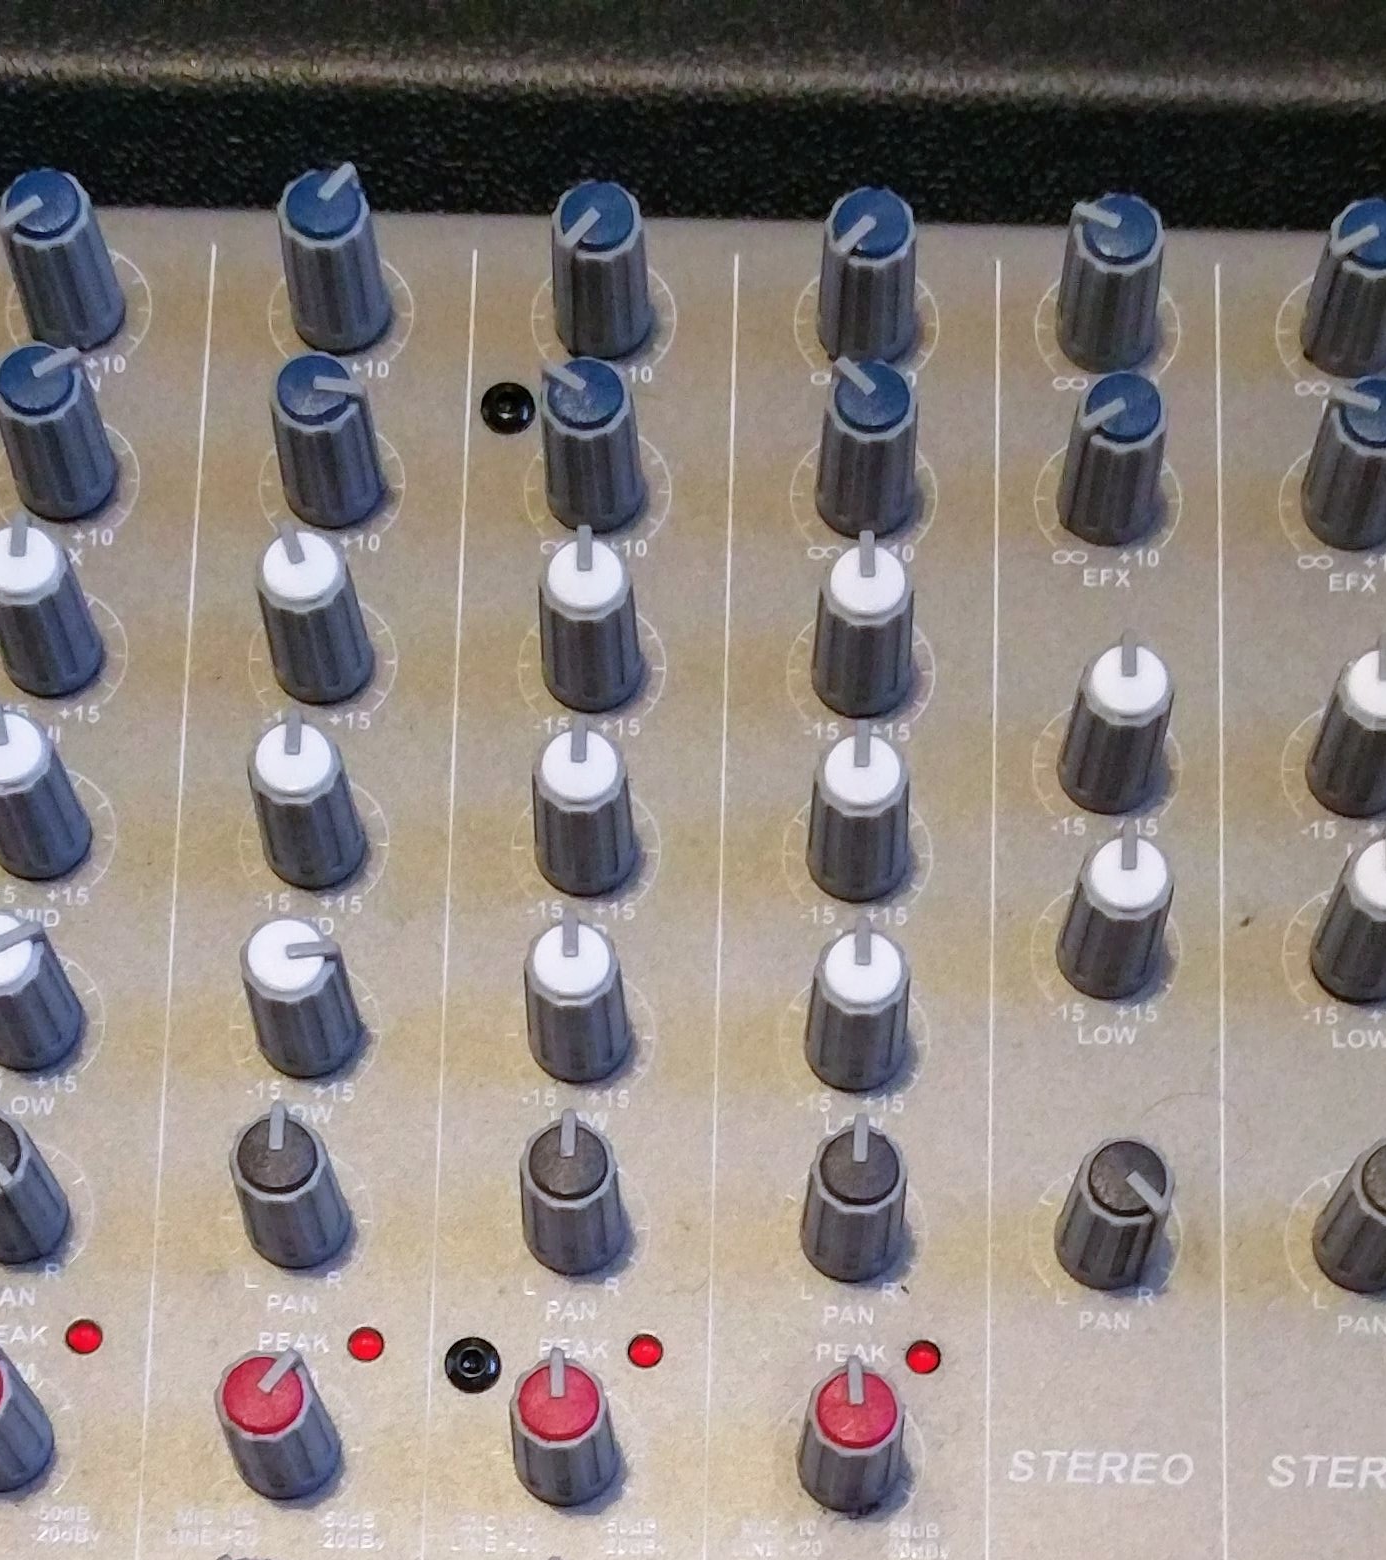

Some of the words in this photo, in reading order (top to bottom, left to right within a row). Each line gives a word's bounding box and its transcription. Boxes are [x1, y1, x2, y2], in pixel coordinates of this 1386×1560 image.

[1083, 569, 1130, 587] EFX
[1328, 574, 1377, 593] EFX
[1078, 1026, 1138, 1046] LOW
[1079, 1311, 1131, 1331] PAN
[1009, 1451, 1194, 1485] STEREO
